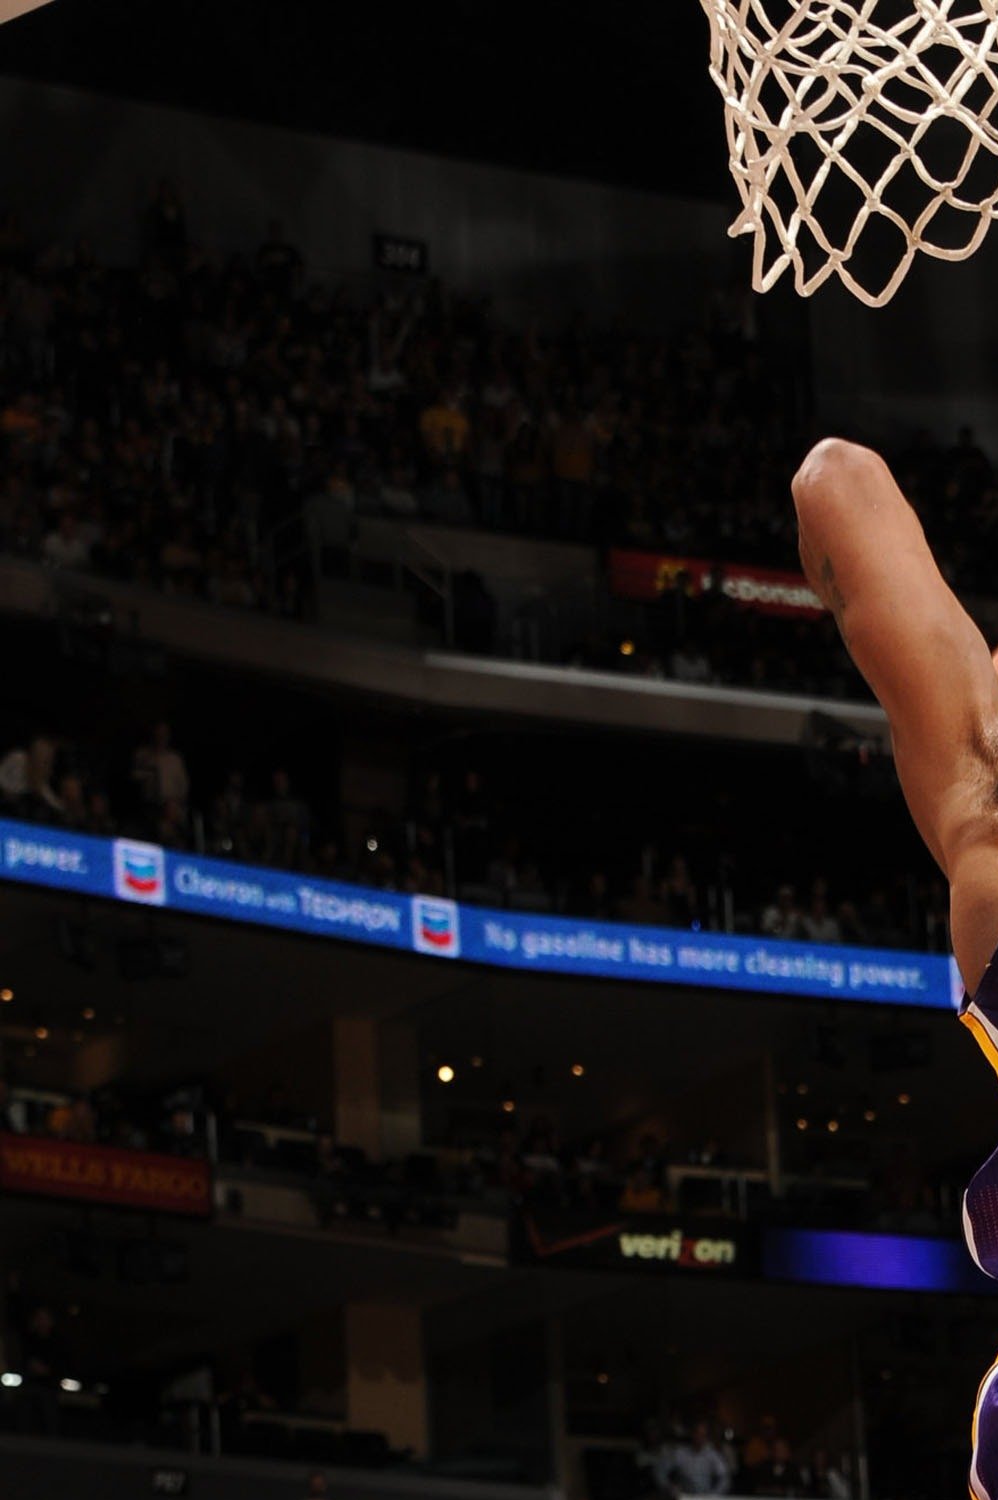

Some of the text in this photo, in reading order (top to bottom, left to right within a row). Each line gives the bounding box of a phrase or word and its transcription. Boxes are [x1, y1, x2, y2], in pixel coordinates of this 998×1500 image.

[5, 837, 88, 874] power.
[174, 865, 265, 906] Chevron
[484, 922, 926, 991] No gasoline has more cleaning power.
[619, 1229, 736, 1267] verizon
